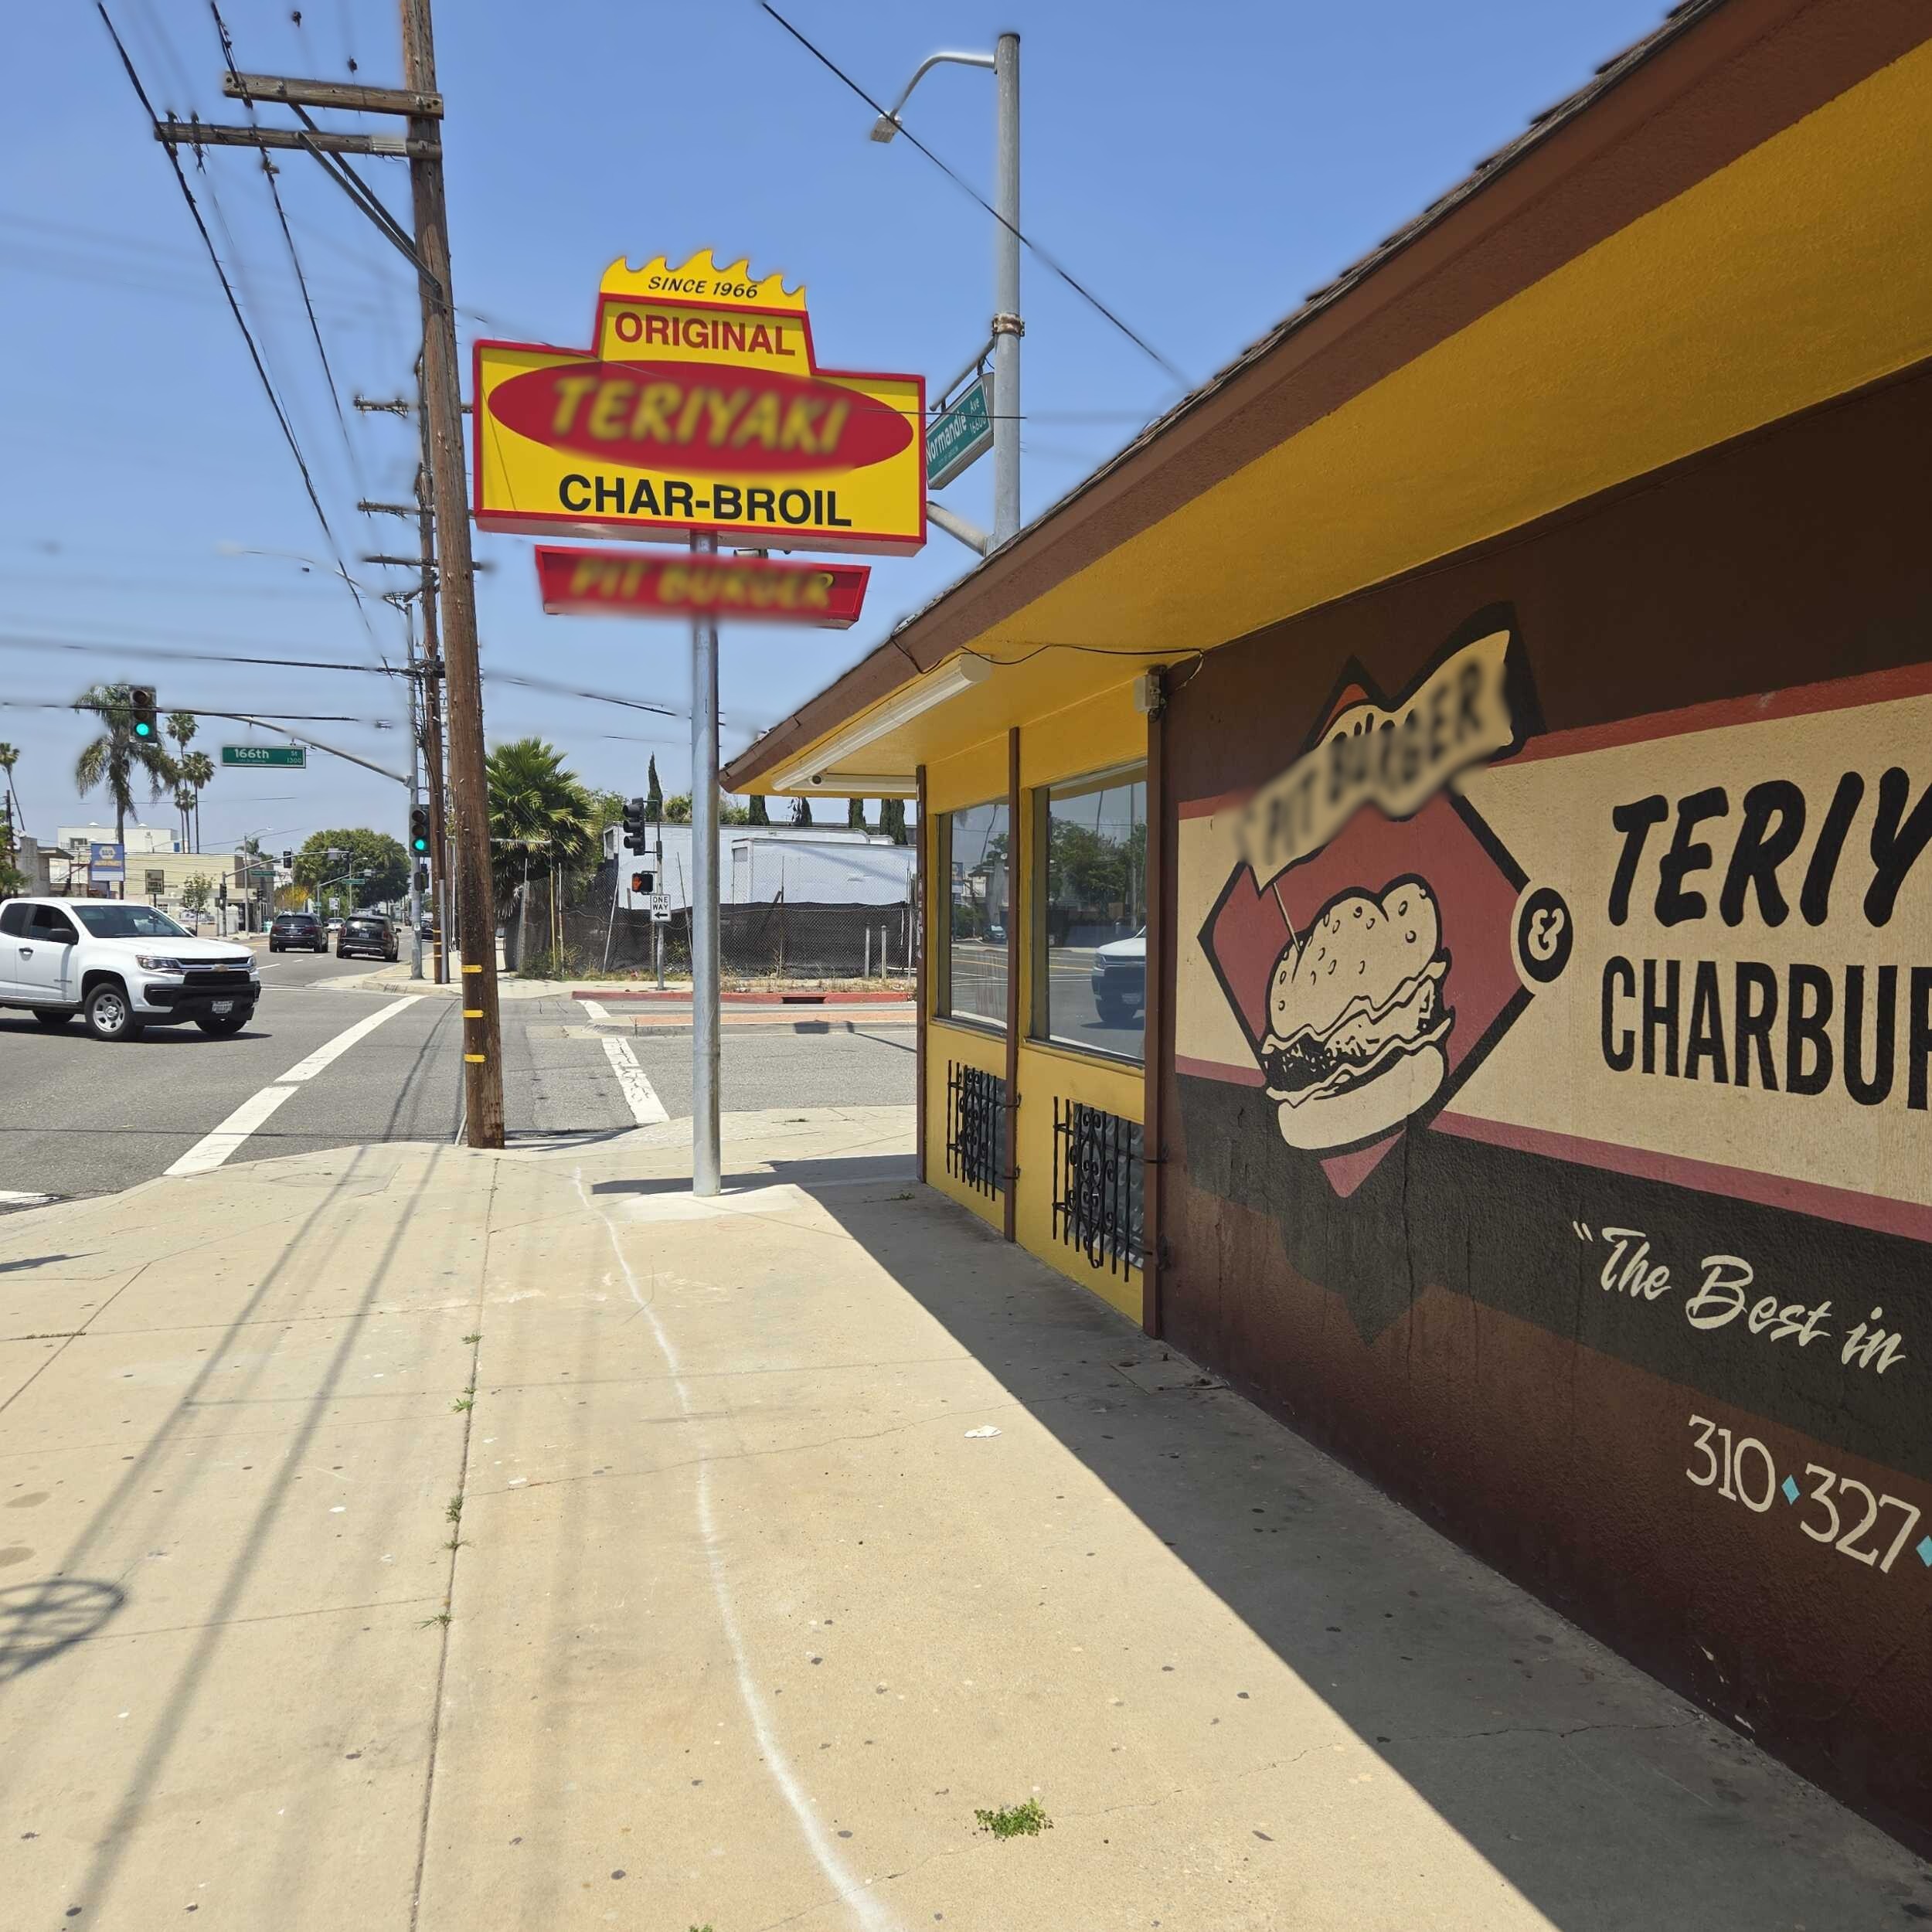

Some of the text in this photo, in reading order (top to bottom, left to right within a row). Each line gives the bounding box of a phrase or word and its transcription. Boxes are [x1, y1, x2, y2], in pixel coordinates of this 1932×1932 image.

[648, 276, 758, 298] SINCE 1966
[615, 311, 795, 356] ORIGINAL
[552, 375, 848, 454] TERIYAKI
[970, 397, 980, 414] Ave
[559, 474, 852, 527] CHAR-BROIL
[234, 748, 270, 759] 166th
[1527, 908, 1565, 961] &
[1685, 1254, 1832, 1346] Best
[1841, 1306, 1906, 1373] in
[1685, 1413, 1921, 1573] 310 327
